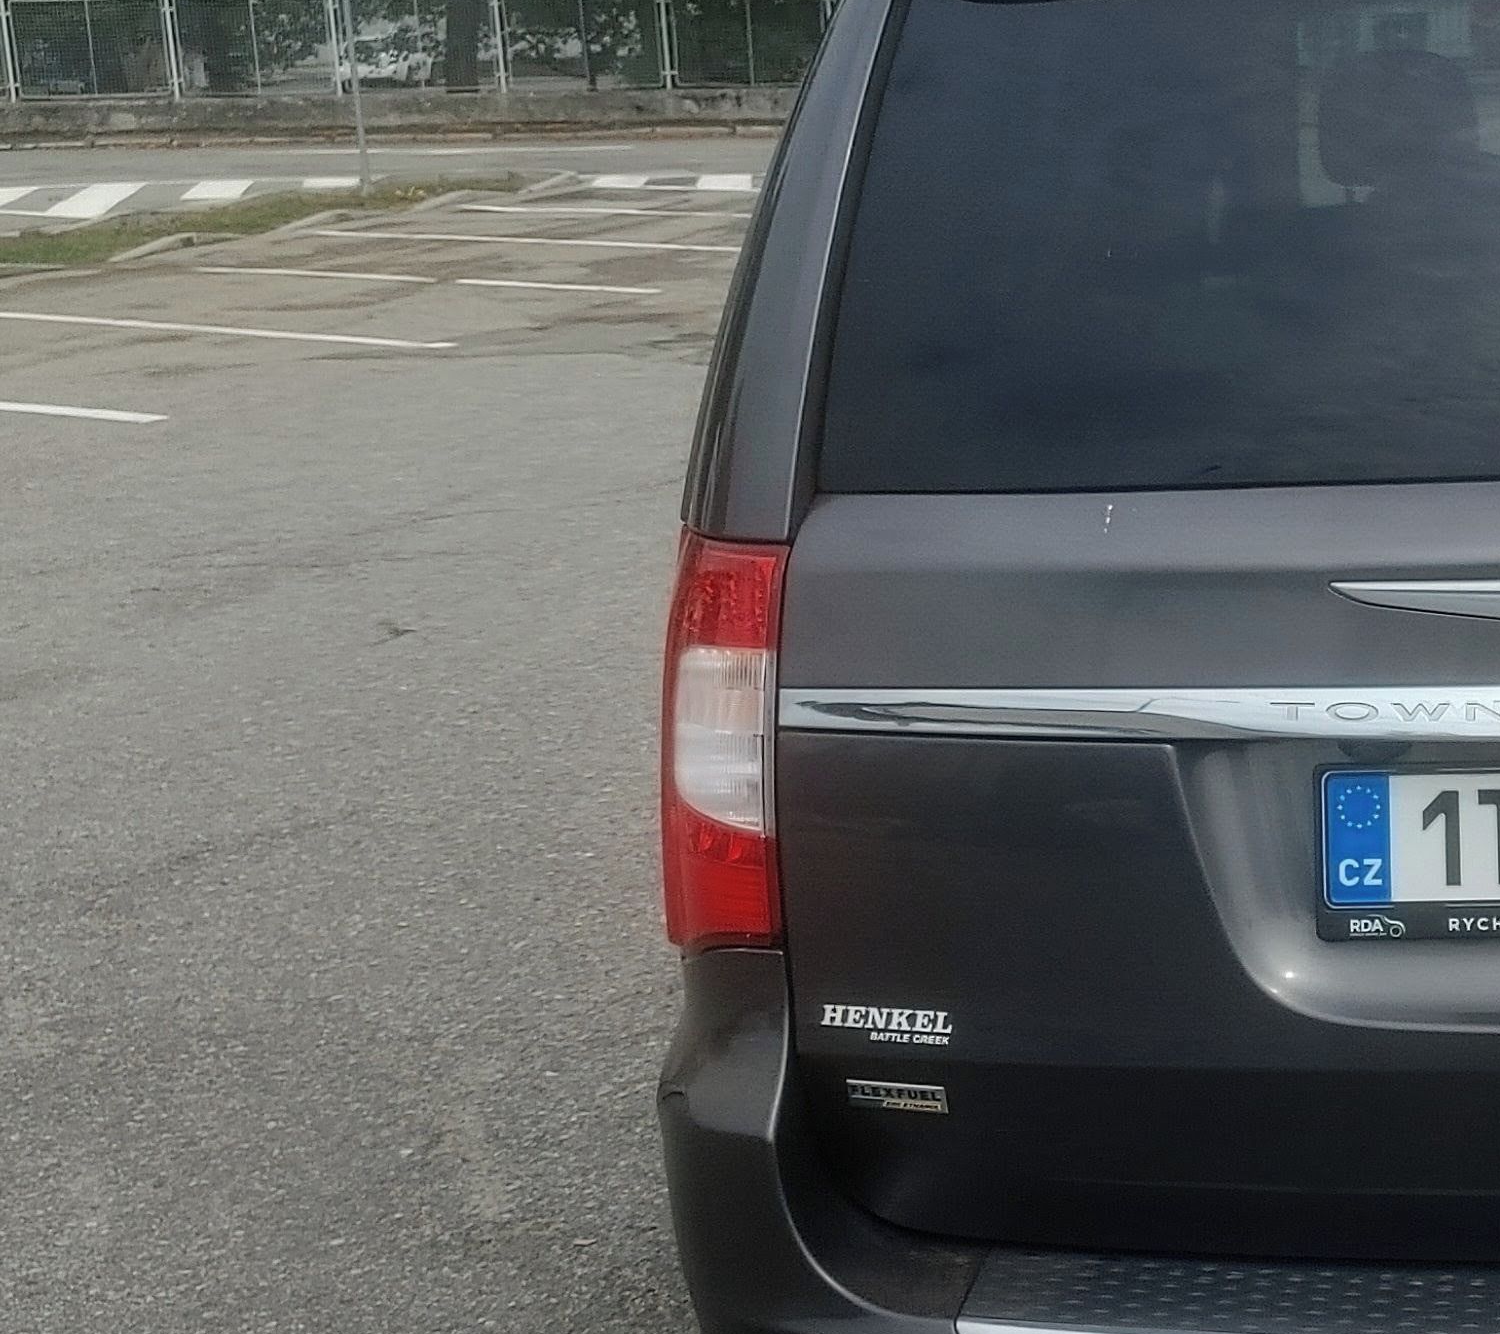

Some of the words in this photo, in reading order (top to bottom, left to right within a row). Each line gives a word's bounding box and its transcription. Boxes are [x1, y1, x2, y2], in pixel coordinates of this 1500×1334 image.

[1338, 858, 1383, 888] CZ
[1350, 919, 1384, 933] RDA
[821, 1004, 953, 1034] HENKEL
[870, 1032, 911, 1044] BATTLE
[913, 1034, 950, 1045] CREEK
